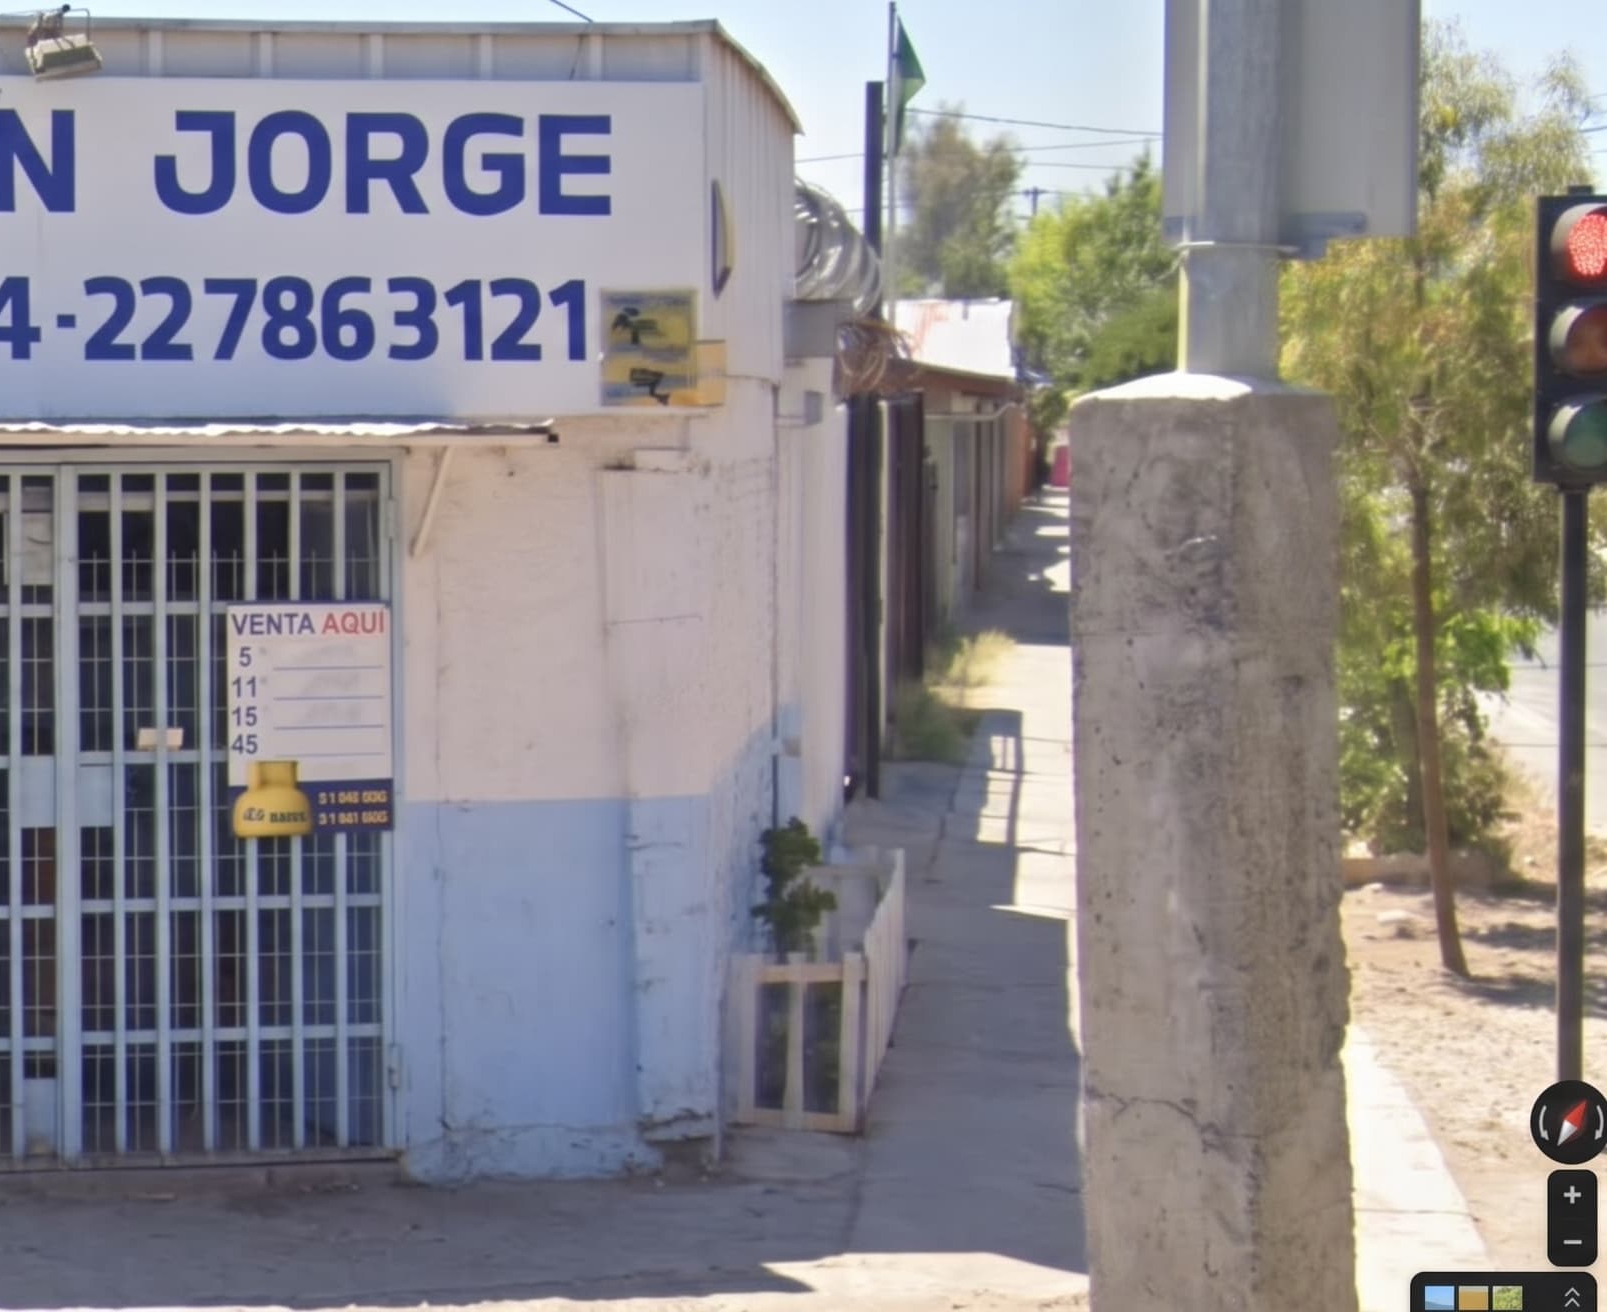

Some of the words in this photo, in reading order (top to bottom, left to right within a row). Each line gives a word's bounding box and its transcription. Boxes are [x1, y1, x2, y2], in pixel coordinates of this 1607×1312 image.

[154, 112, 611, 216] JORGE
[231, 613, 315, 635] VENTA
[239, 646, 252, 667] 5
[232, 676, 256, 698] 11
[232, 706, 258, 727] 15
[232, 734, 258, 754] 45
